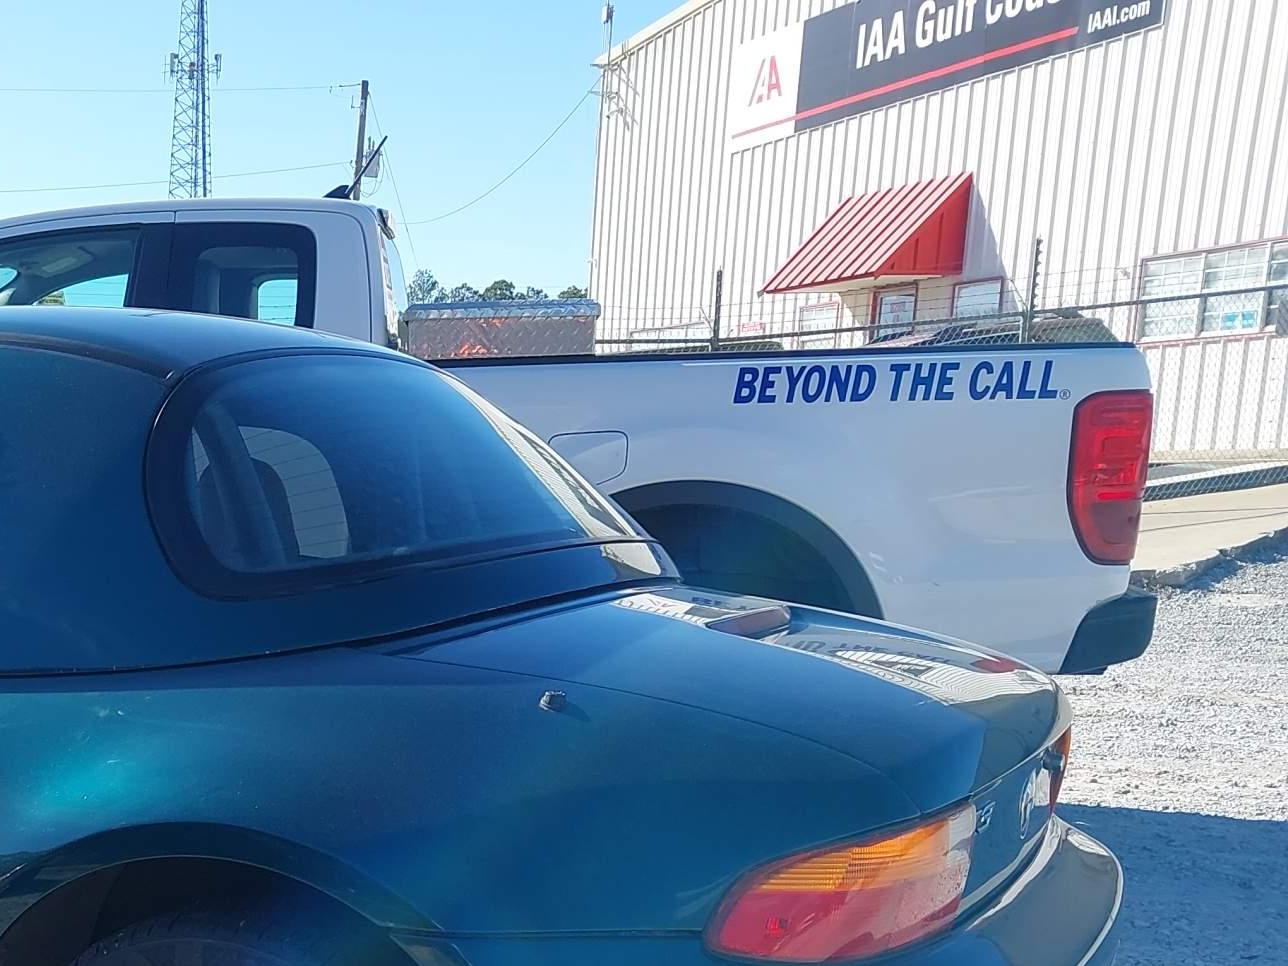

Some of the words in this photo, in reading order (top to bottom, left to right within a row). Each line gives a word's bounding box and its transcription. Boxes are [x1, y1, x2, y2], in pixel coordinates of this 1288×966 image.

[856, 10, 906, 69] IAA
[915, 0, 977, 48] Gulf
[985, 0, 1062, 25] Co
[1087, 0, 1151, 34] IAAI.com
[733, 365, 877, 404] BEYOND
[889, 362, 961, 401] THE
